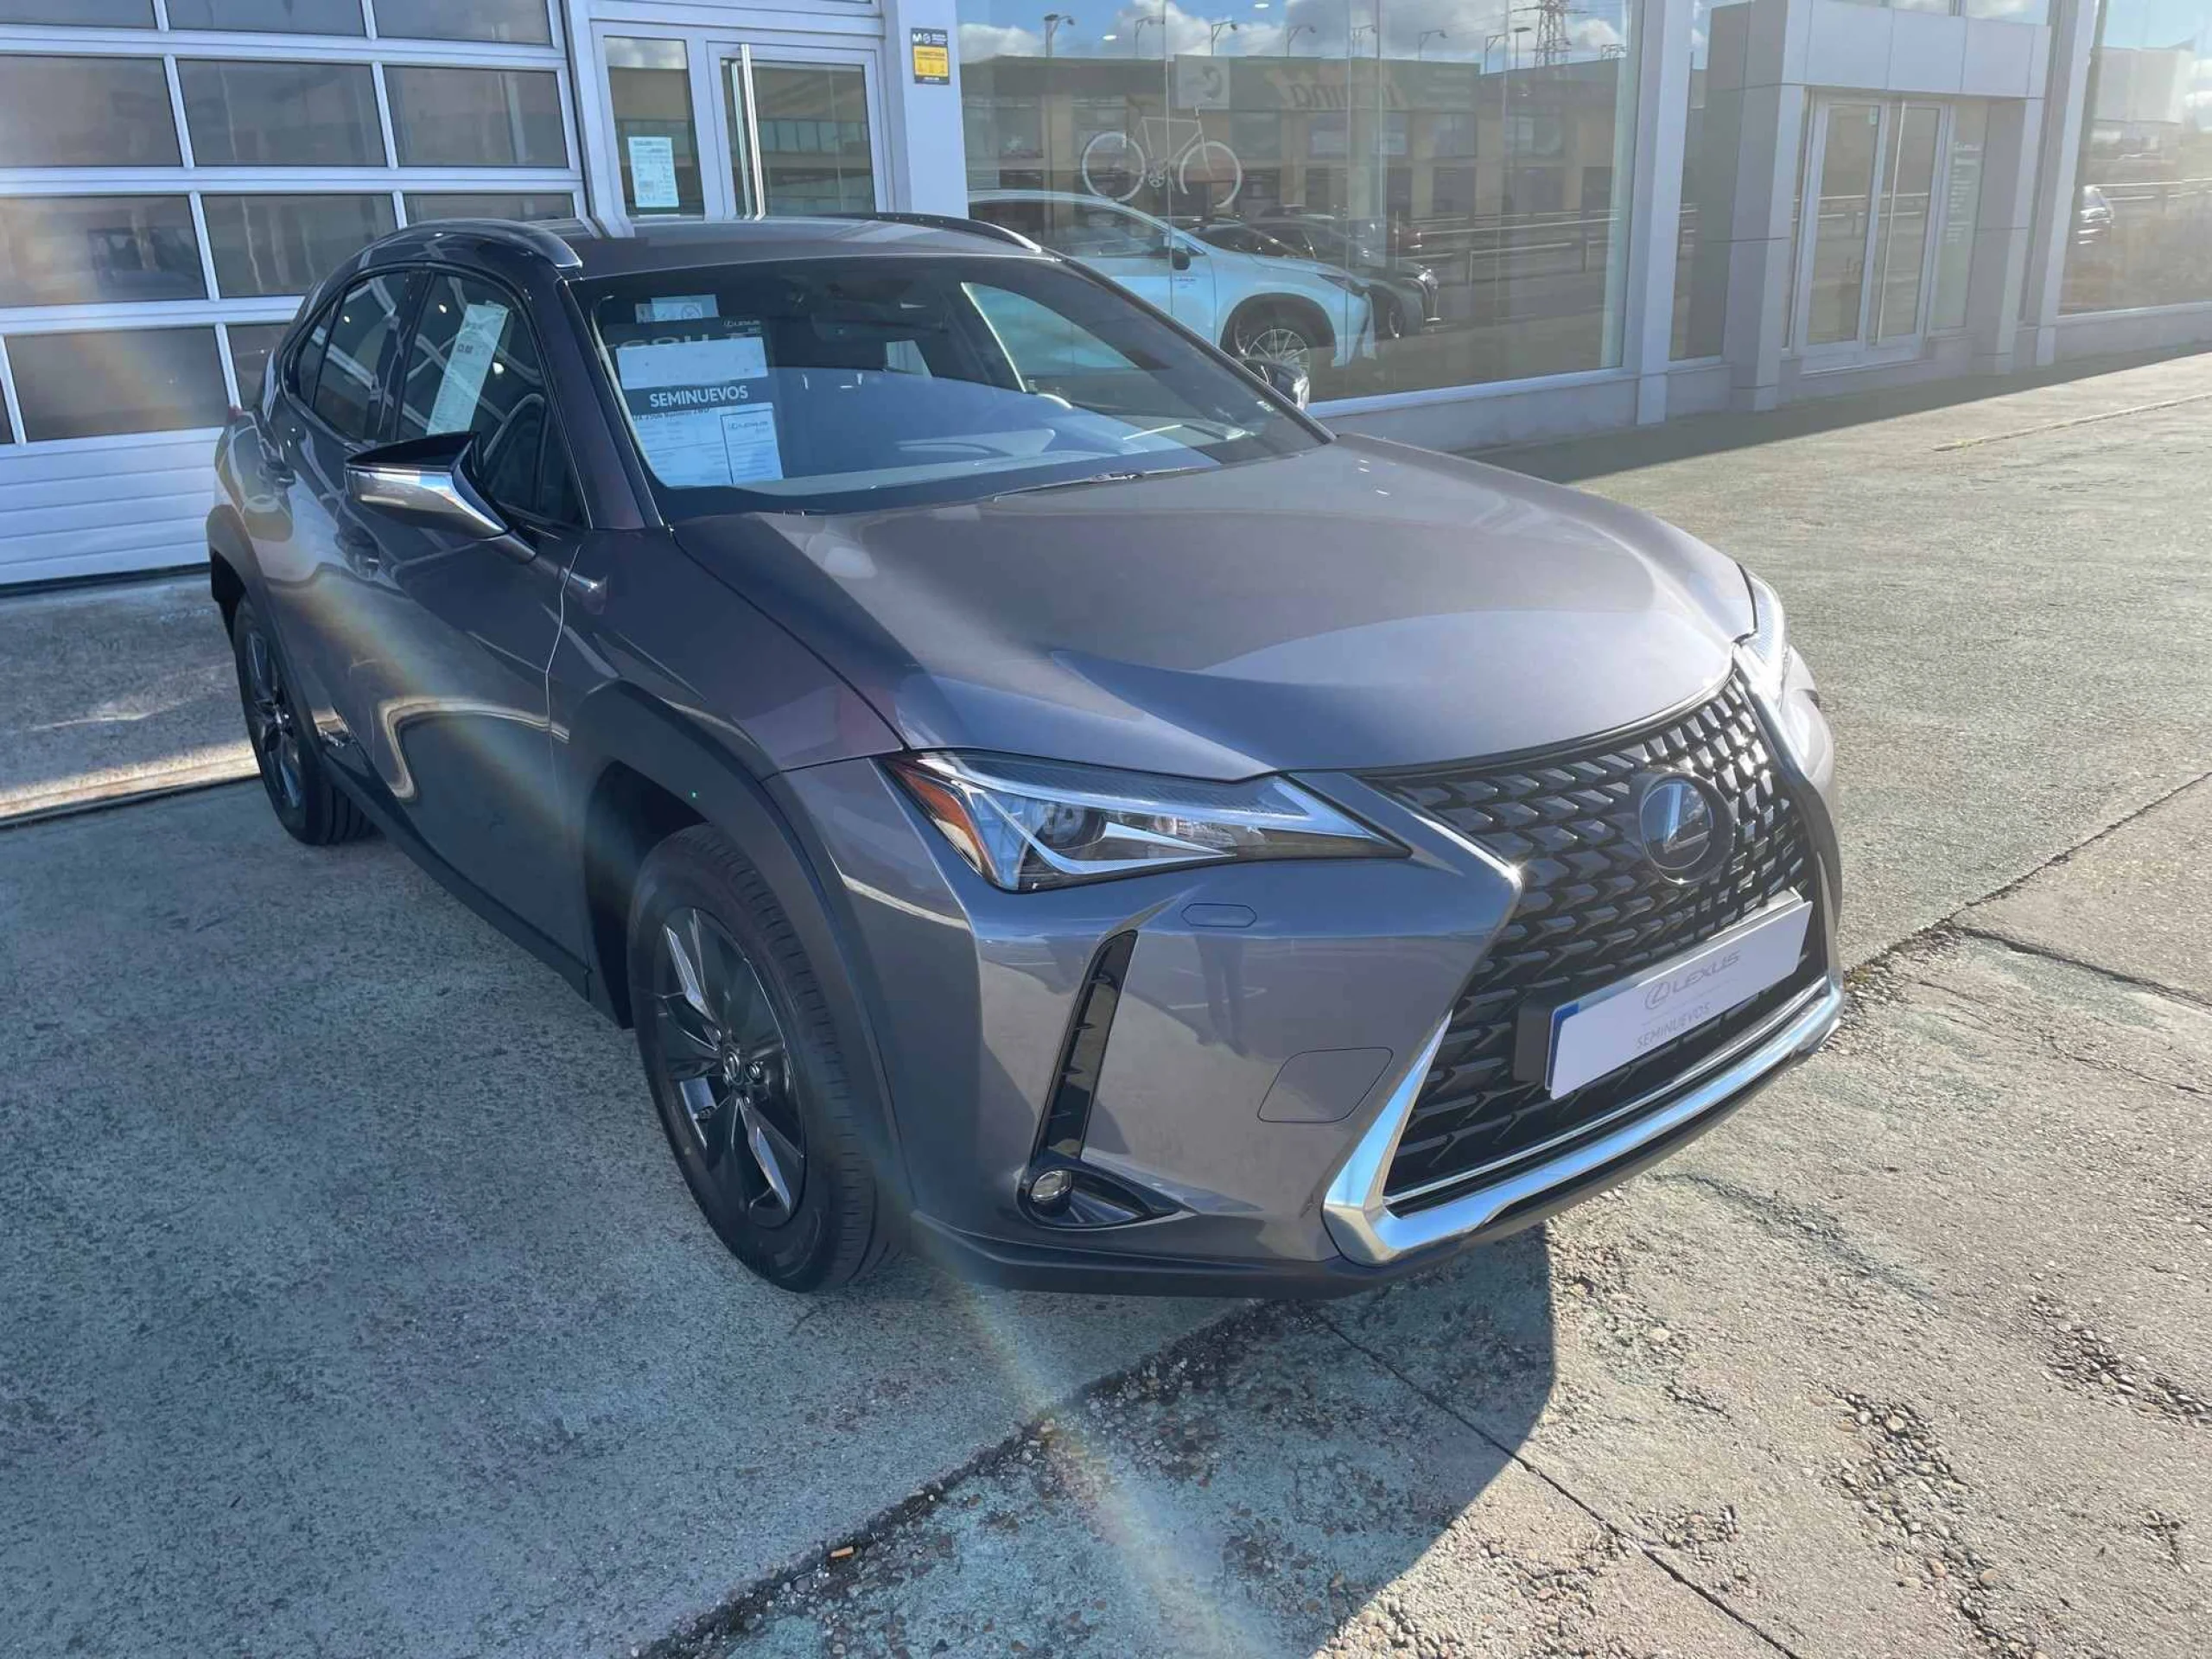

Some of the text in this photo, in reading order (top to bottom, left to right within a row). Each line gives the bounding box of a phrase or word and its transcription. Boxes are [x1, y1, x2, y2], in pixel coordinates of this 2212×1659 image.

[649, 385, 749, 408] SEMINUEVOS
[1672, 950, 1741, 993] LEXUS
[1637, 1001, 1712, 1049] SEMINUEVOS
